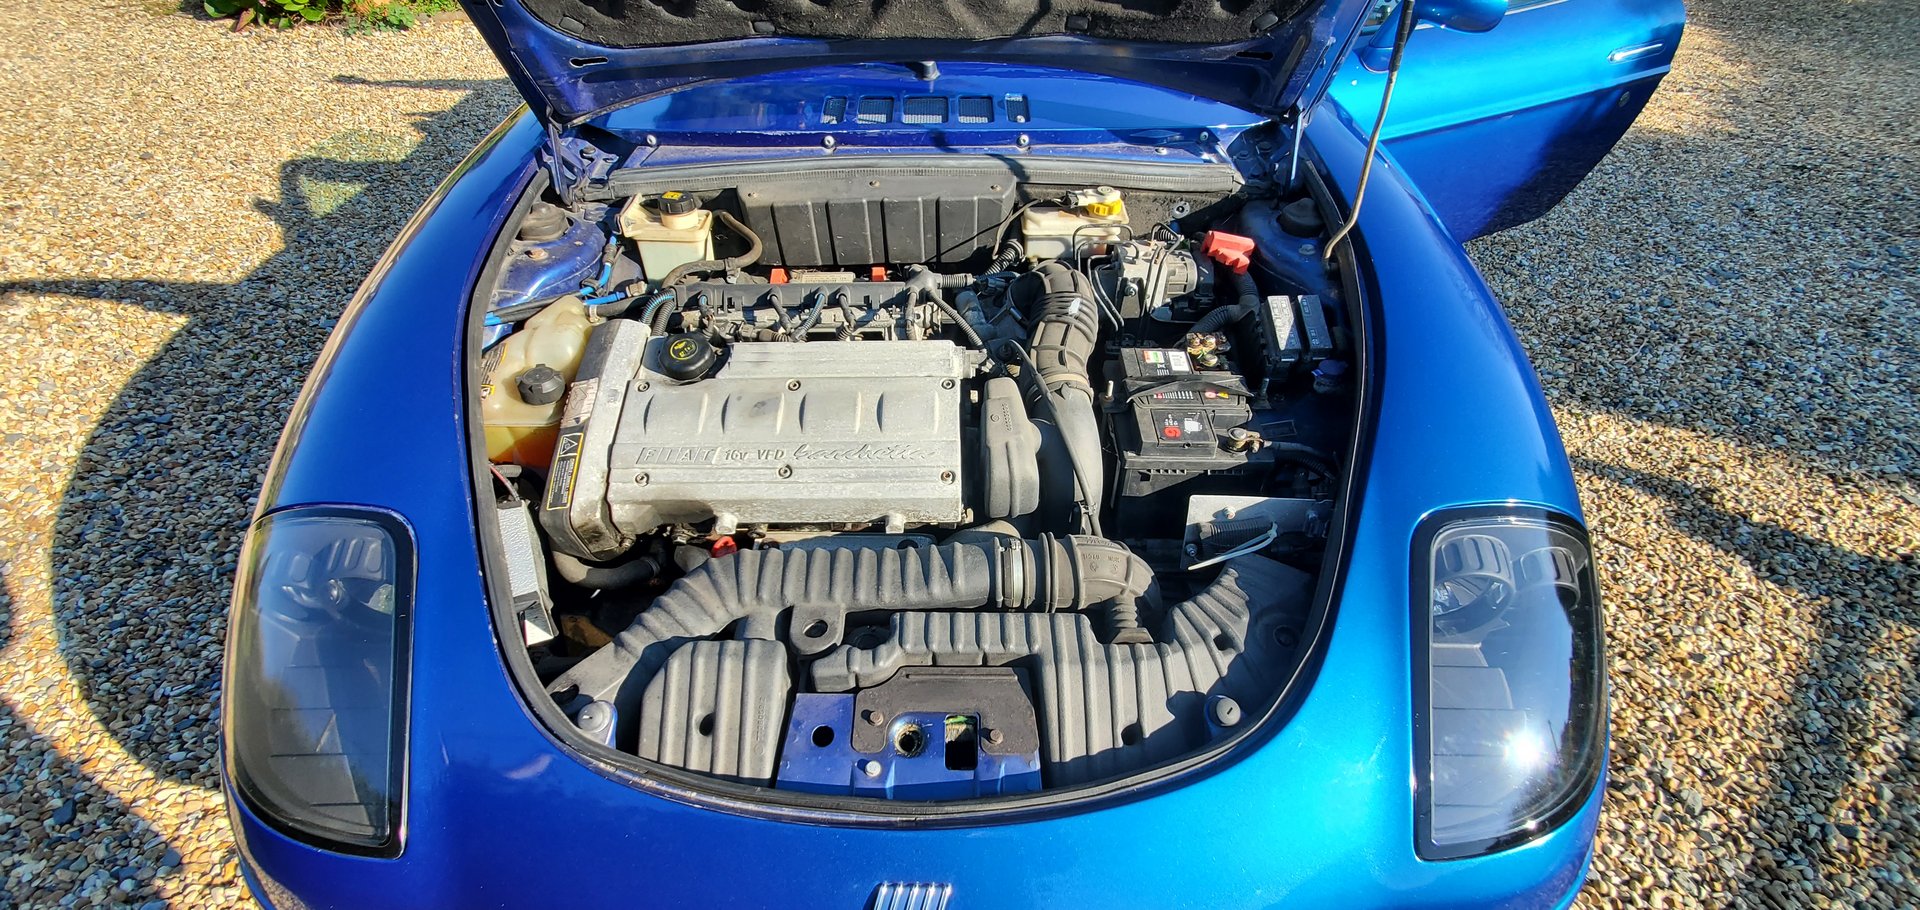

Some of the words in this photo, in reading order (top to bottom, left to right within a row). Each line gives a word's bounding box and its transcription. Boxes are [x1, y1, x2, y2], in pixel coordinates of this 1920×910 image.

[640, 448, 716, 463] FIAT
[725, 448, 748, 461] 16v
[757, 449, 785, 460] VFD
